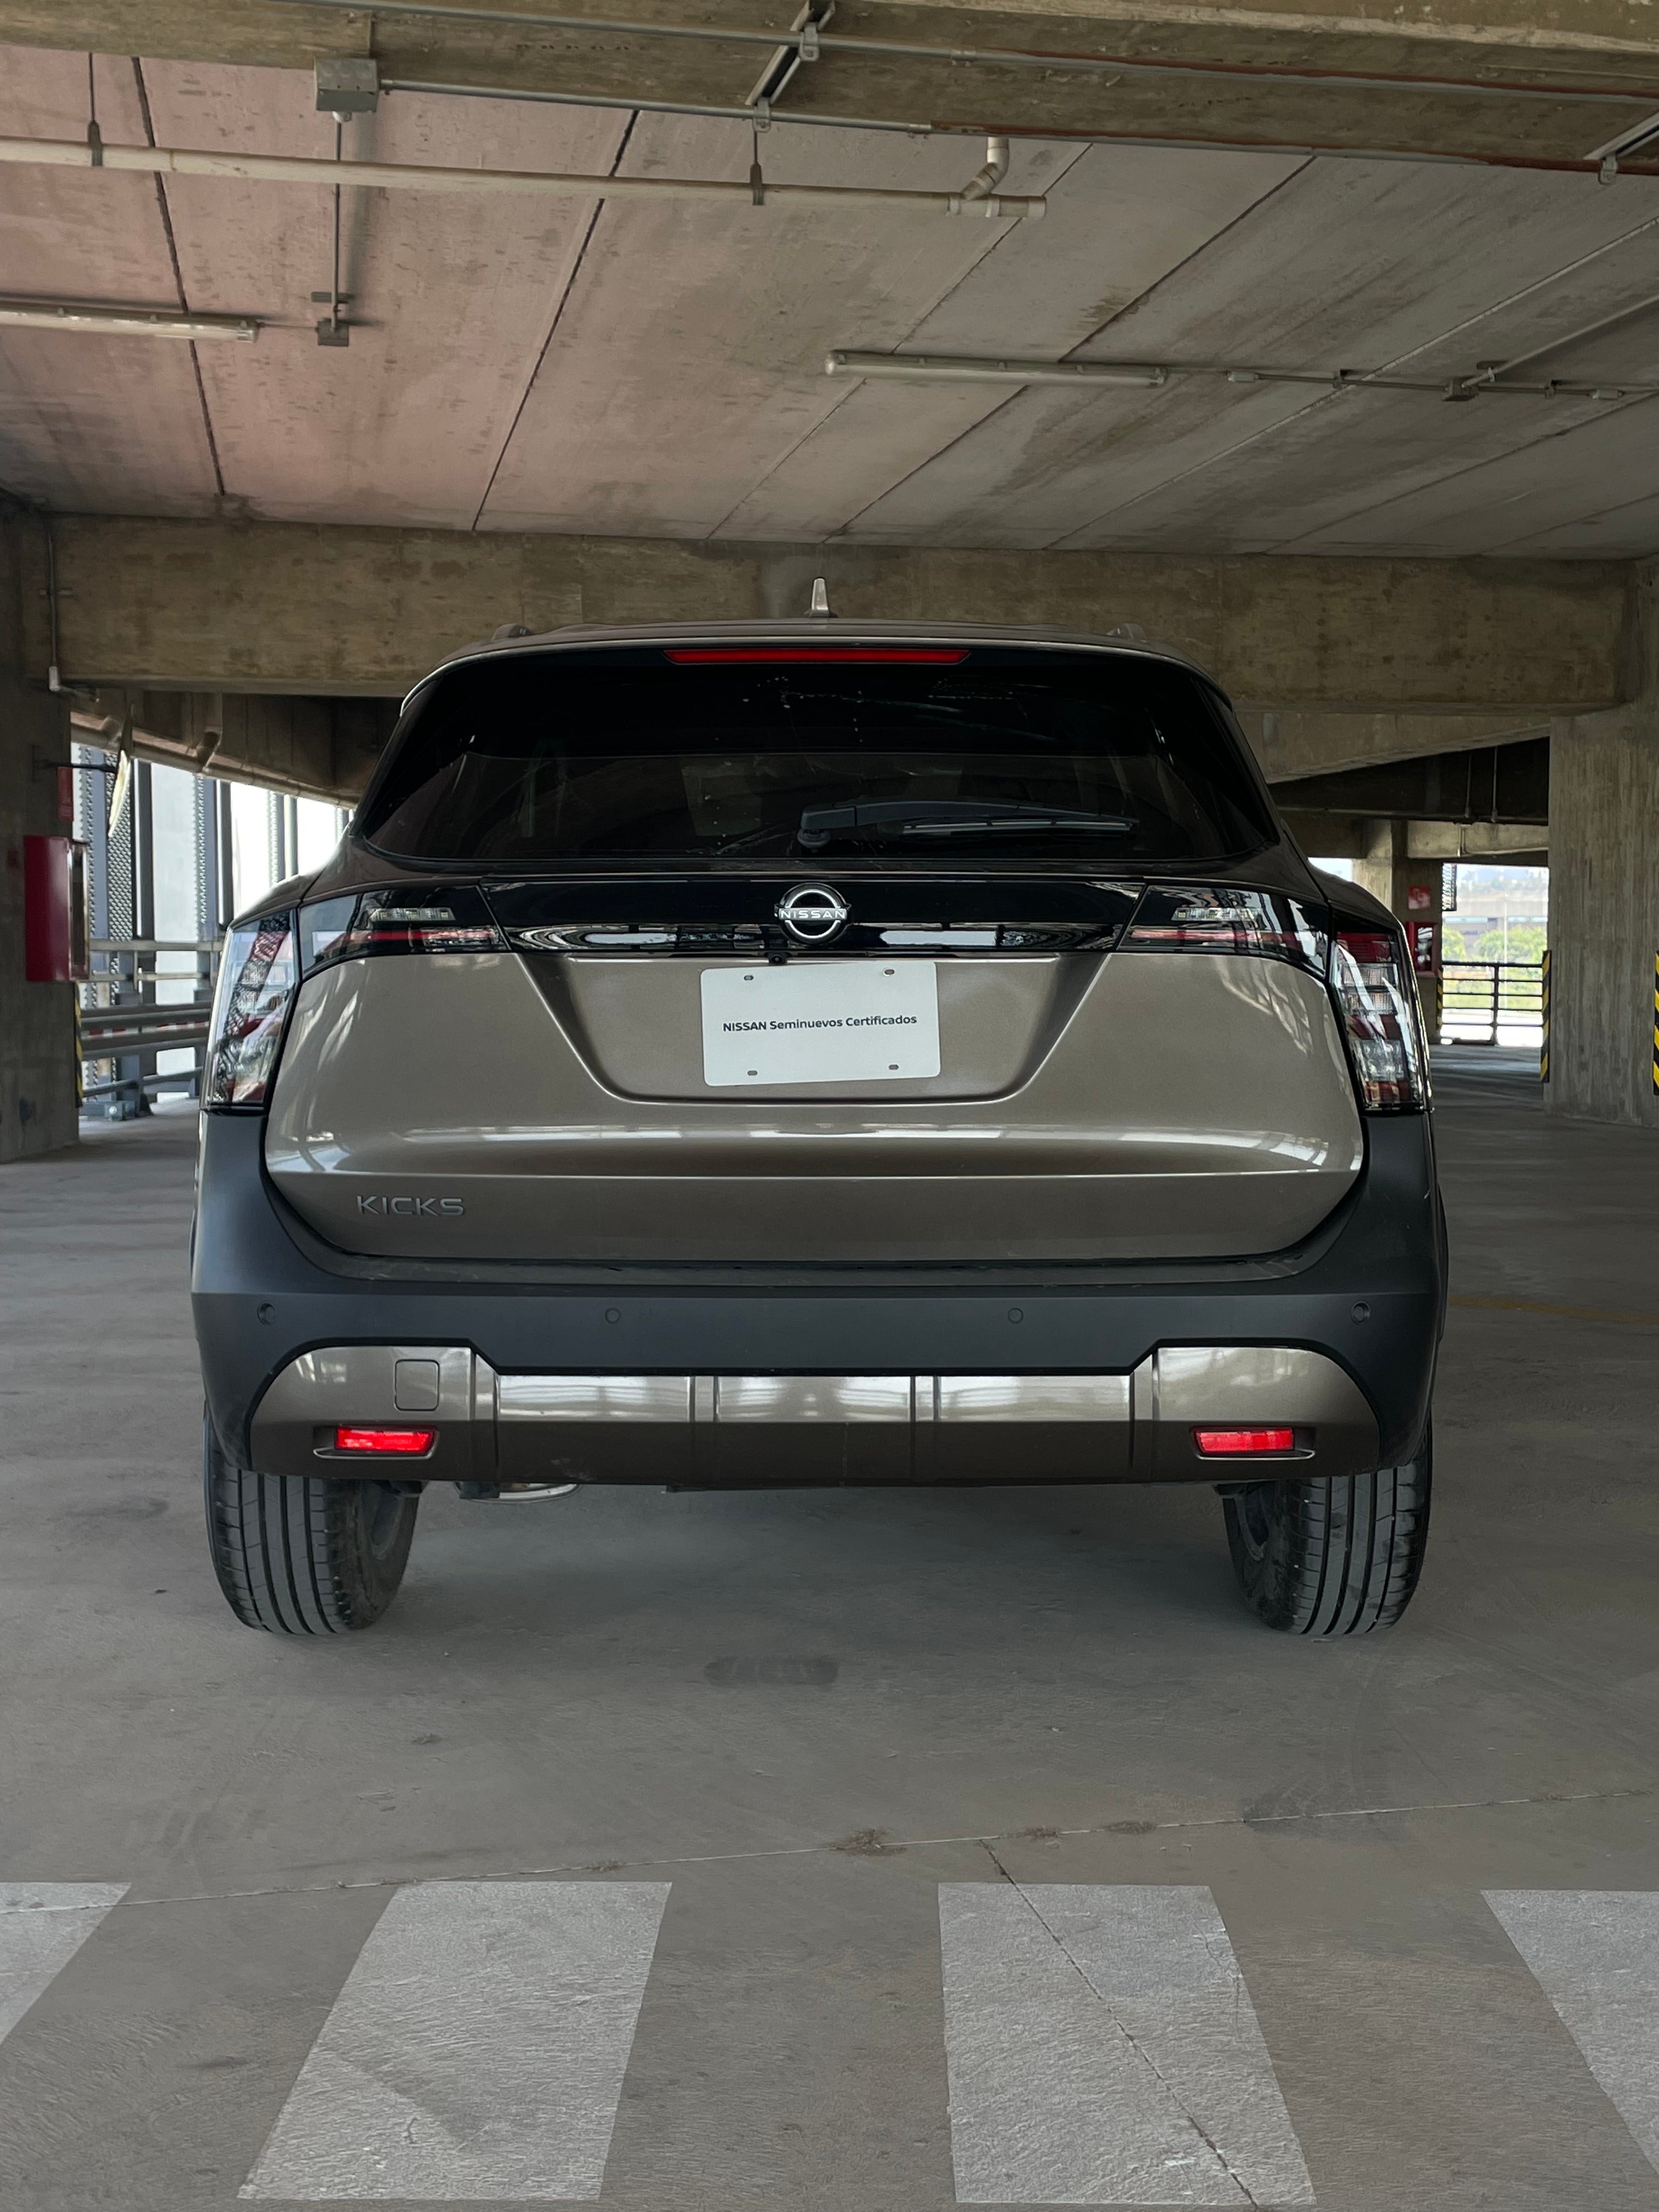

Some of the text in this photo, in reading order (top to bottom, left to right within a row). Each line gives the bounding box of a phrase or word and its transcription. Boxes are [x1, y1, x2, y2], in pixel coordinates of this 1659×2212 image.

[781, 910, 845, 918] NISSAN
[723, 1014, 917, 1032] NISSAN Seminuevos Certificados
[357, 1195, 464, 1216] KICKS
